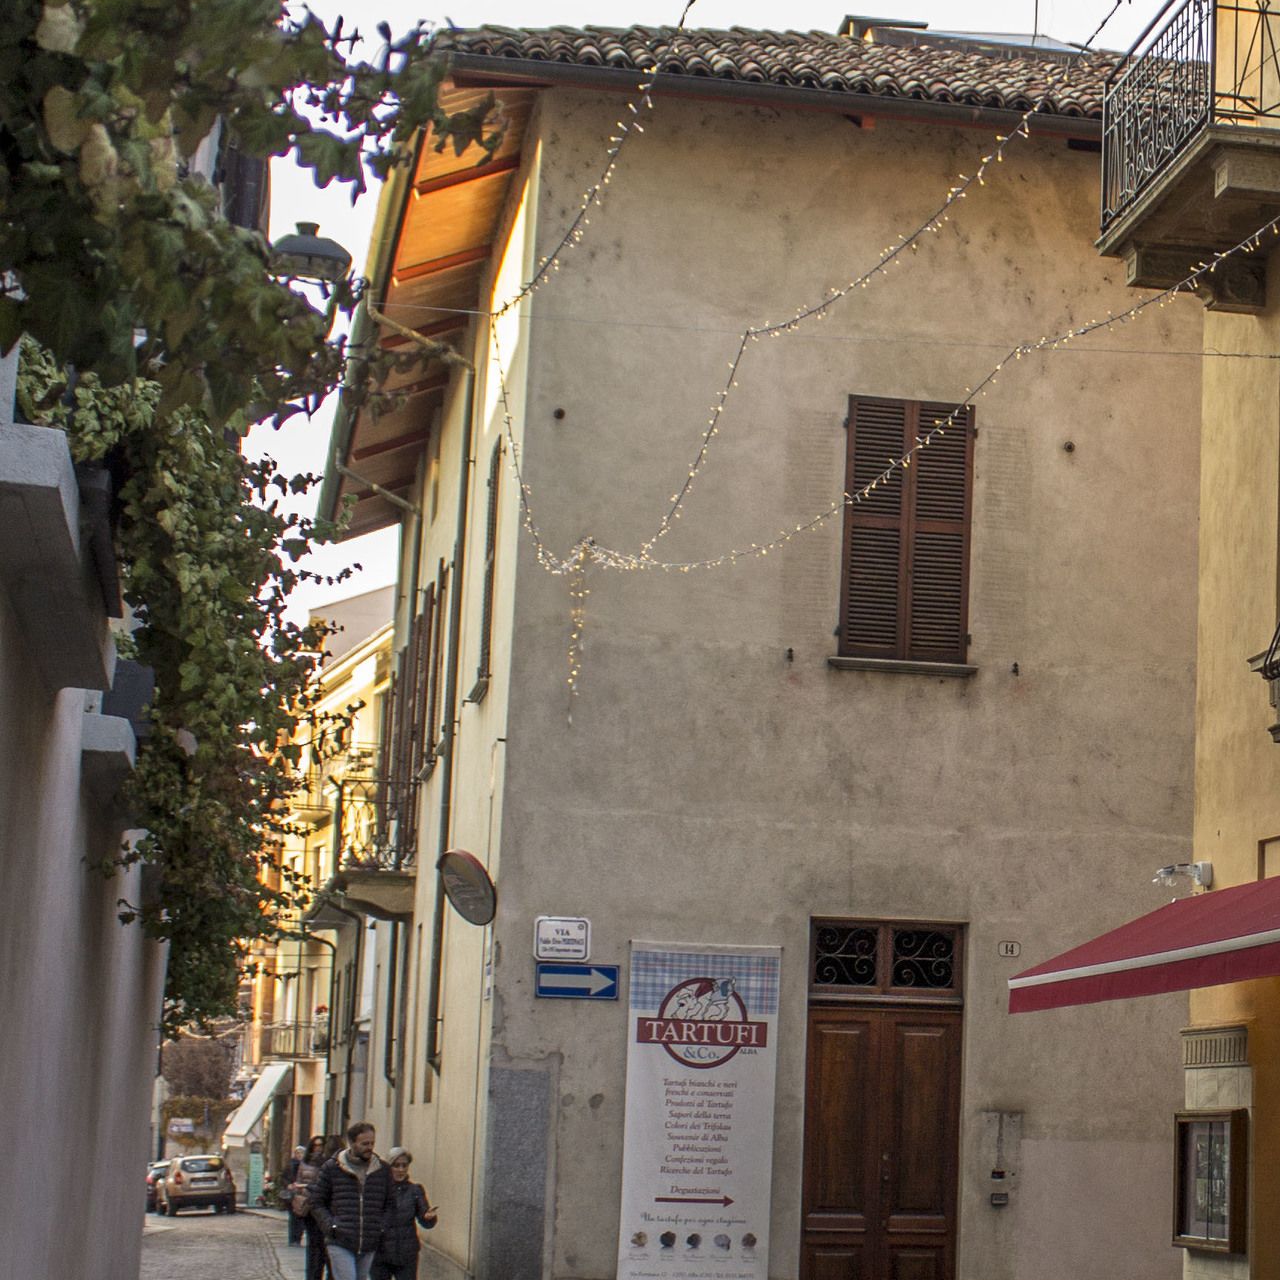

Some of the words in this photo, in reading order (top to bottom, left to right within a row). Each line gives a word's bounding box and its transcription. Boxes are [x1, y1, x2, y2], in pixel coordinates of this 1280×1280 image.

[554, 928, 571, 937] VIA
[646, 1021, 758, 1044] TARTUFI
[683, 1046, 720, 1059] &Co.
[689, 1079, 715, 1087] bianchi
